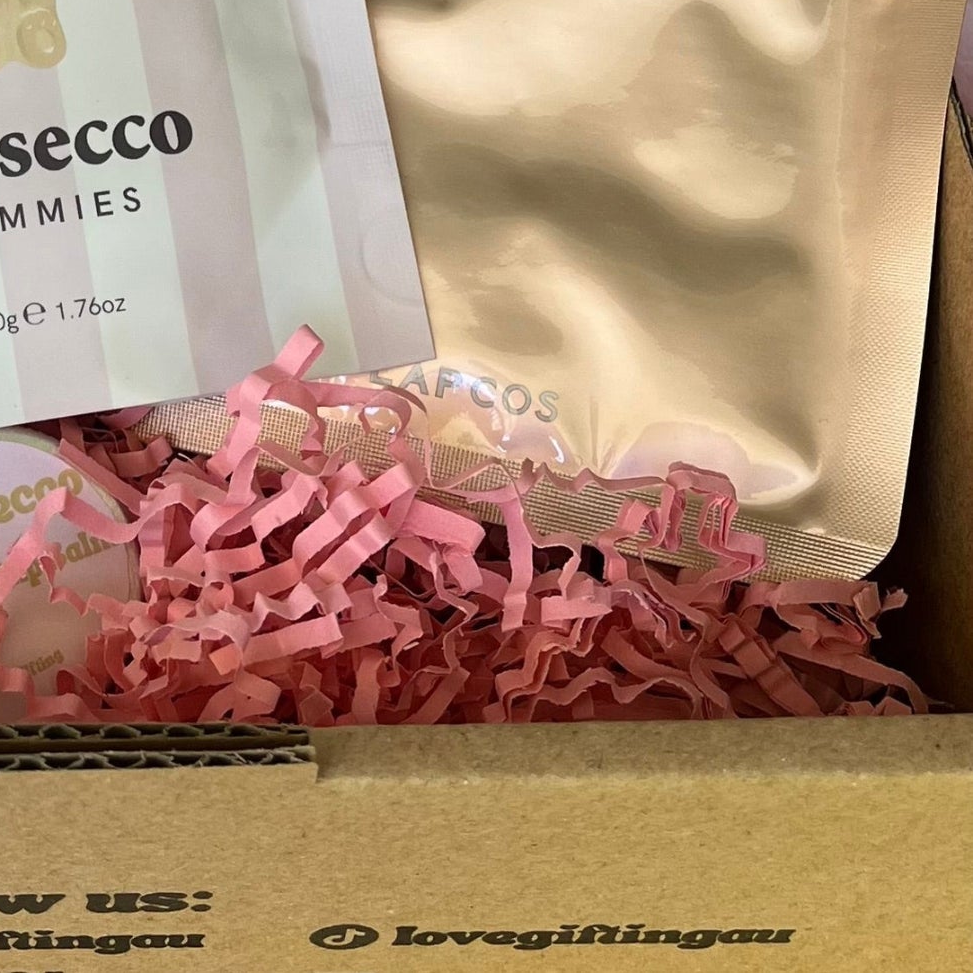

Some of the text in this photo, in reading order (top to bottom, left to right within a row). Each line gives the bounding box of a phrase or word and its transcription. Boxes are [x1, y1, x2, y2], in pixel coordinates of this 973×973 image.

[56, 297, 127, 322] 1.76oz
[85, 891, 215, 913] us:
[391, 923, 797, 950] lovegiftingau
